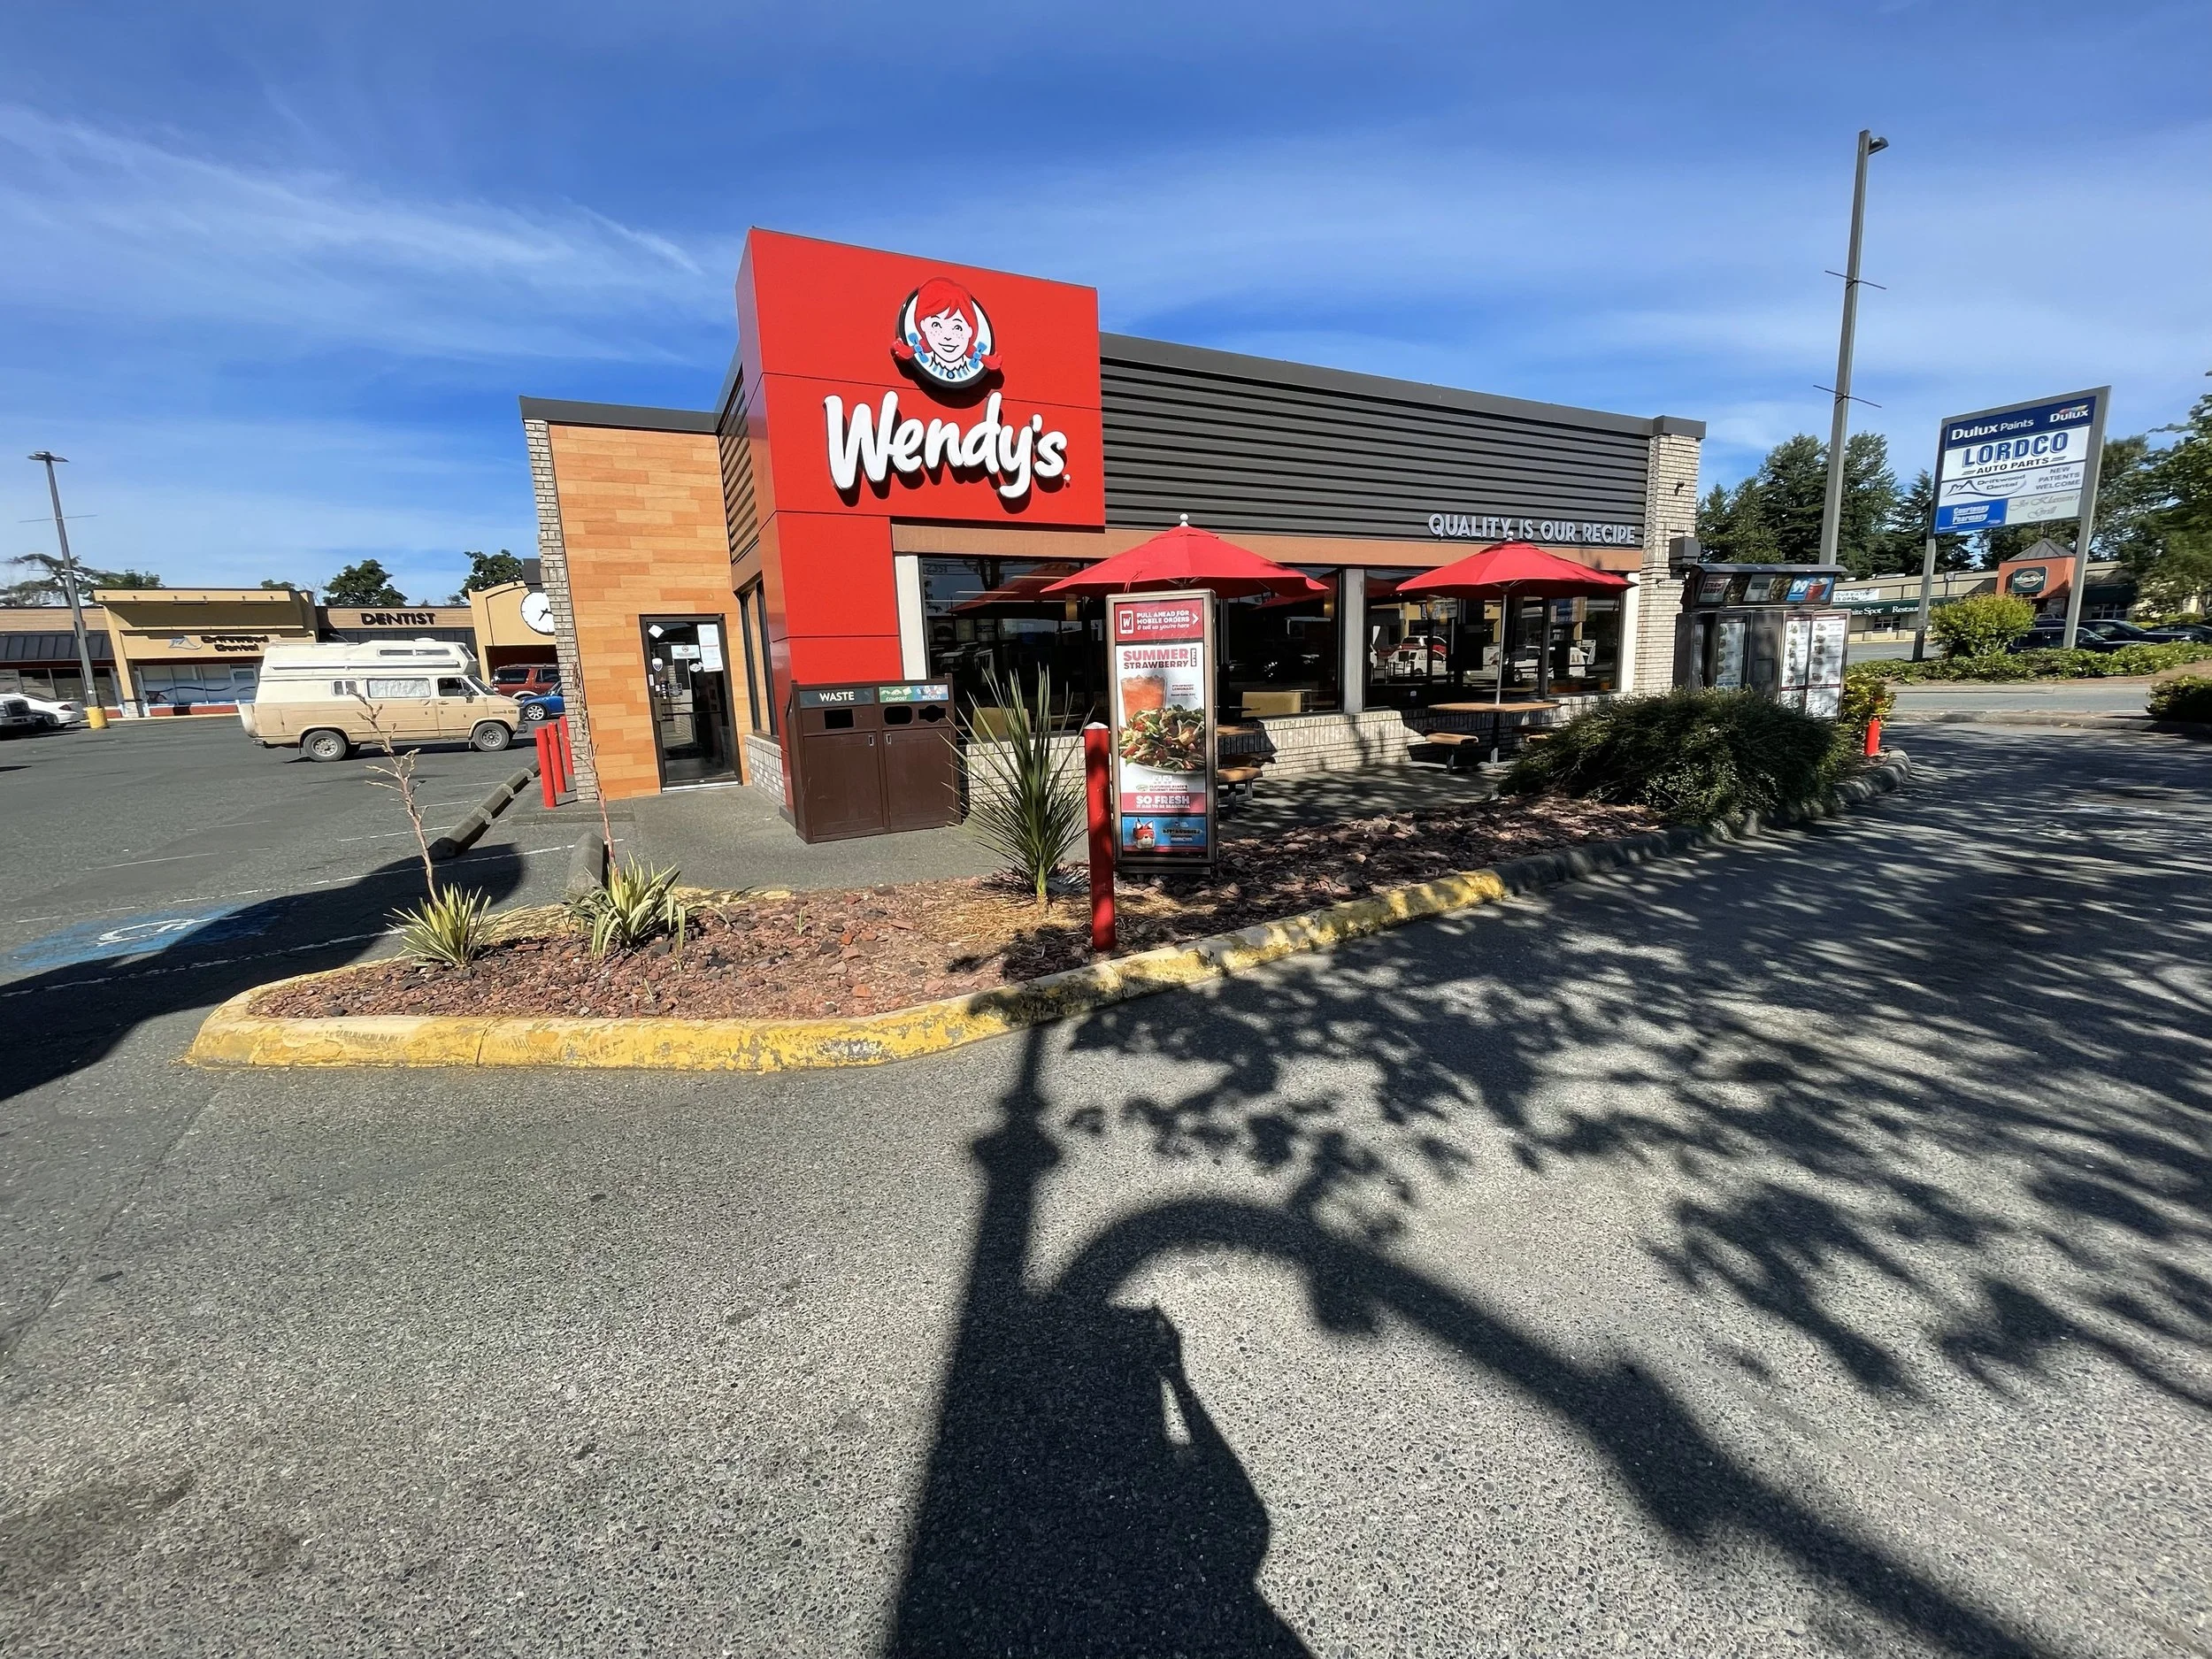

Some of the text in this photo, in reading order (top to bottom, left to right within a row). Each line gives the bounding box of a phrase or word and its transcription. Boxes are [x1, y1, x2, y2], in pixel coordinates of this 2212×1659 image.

[2049, 409, 2089, 423] Dulux
[1951, 419, 2034, 441] Dulux Paints
[823, 390, 1068, 498] Wendy's
[1962, 432, 2069, 467] LORDCO
[1976, 457, 2049, 474] AUTO PARTS
[1977, 474, 2026, 486] Driftwood
[1986, 472, 2080, 490] Dental PATIENTS
[2036, 480, 2081, 490] WELCOME
[1428, 513, 1636, 544] QUALITY IS OUR RECIPE
[1863, 606, 1885, 616] Spot
[361, 613, 435, 625] DENTIST
[1123, 649, 1188, 661] SUMMER
[819, 692, 855, 702] WASTE
[1136, 795, 1152, 804] SO
